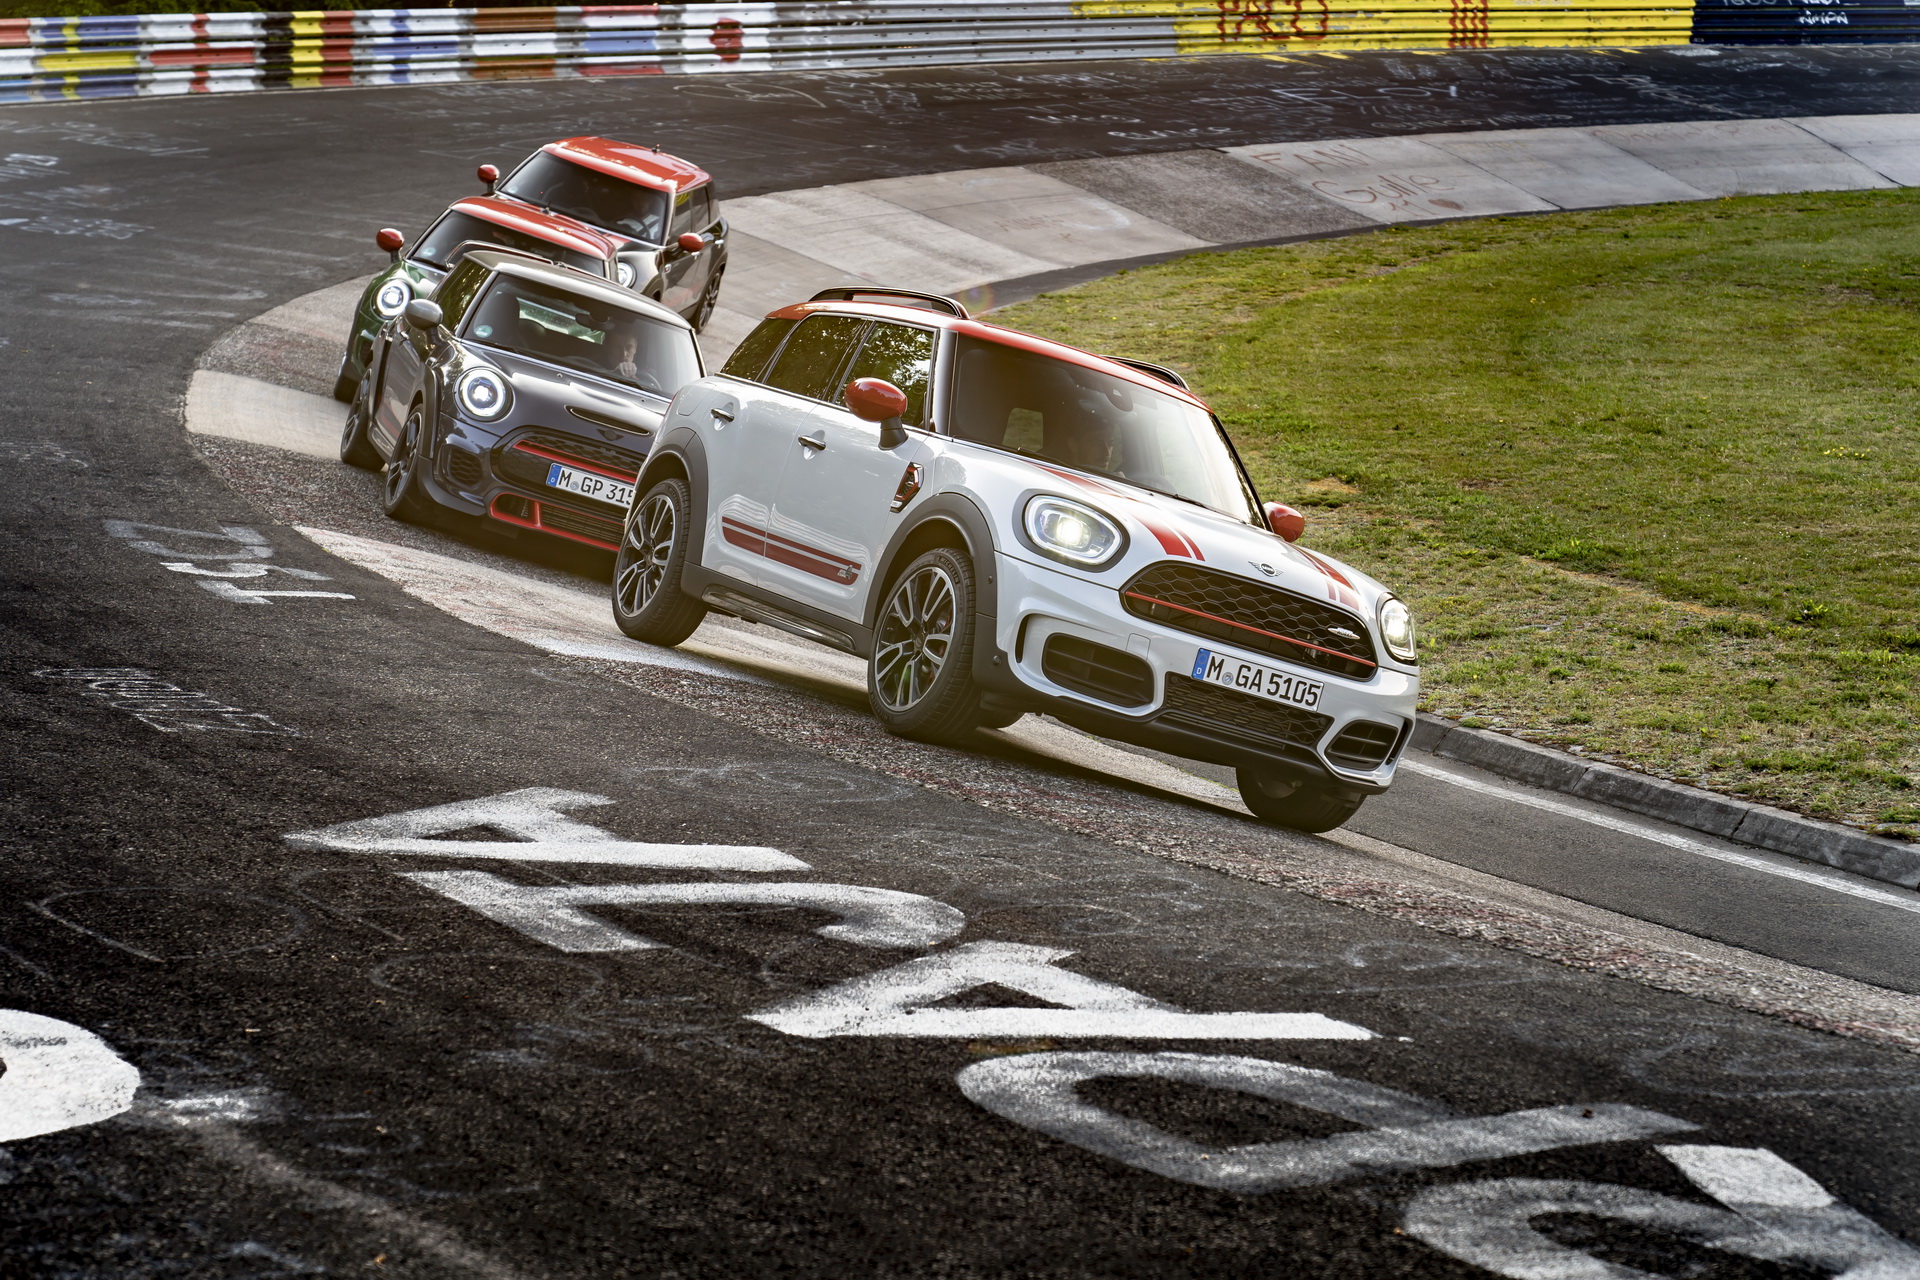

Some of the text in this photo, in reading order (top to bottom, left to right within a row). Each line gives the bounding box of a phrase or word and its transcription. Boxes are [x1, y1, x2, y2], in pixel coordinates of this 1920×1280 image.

[558, 469, 571, 487] M
[580, 476, 604, 495] GP
[939, 557, 960, 584] MICHELIN
[1196, 667, 1203, 676] D
[1206, 656, 1321, 706] M GA 5105
